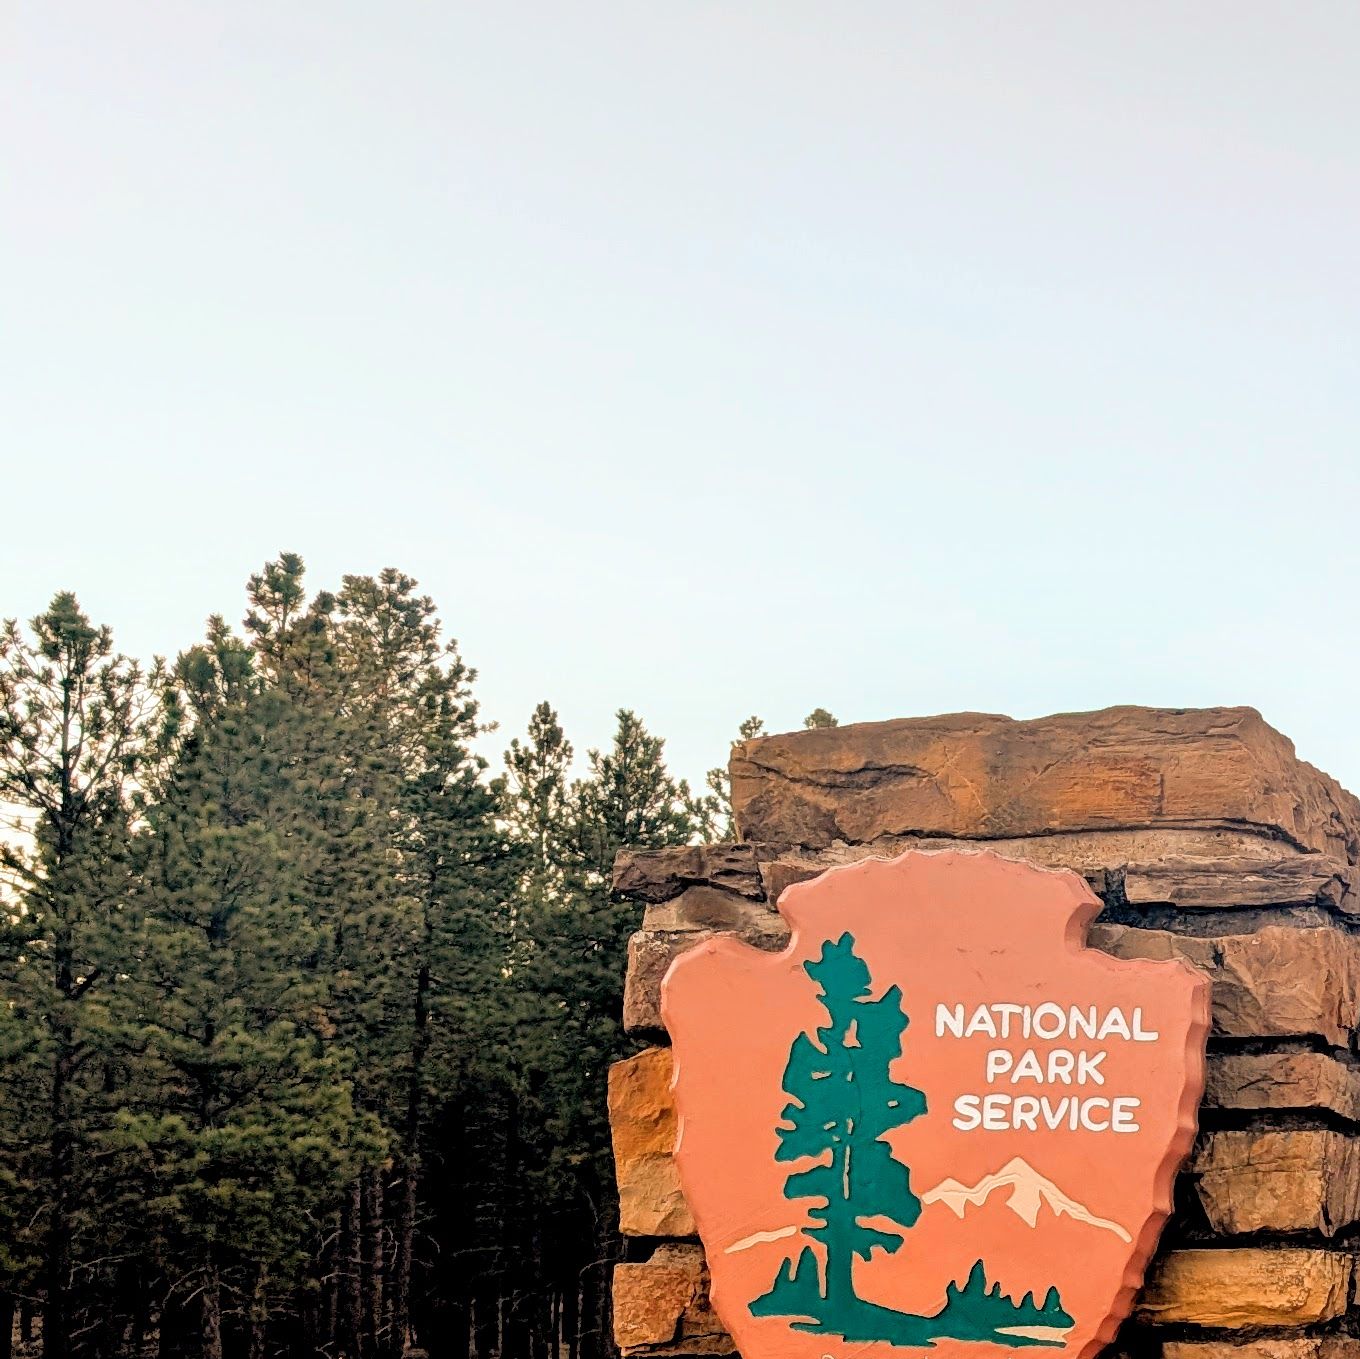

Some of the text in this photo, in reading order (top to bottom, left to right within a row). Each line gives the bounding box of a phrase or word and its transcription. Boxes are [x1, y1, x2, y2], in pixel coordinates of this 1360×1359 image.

[935, 1002, 1159, 1041] NATIONAL
[986, 1049, 1107, 1085] PARK
[952, 1093, 1141, 1133] SERVICE
